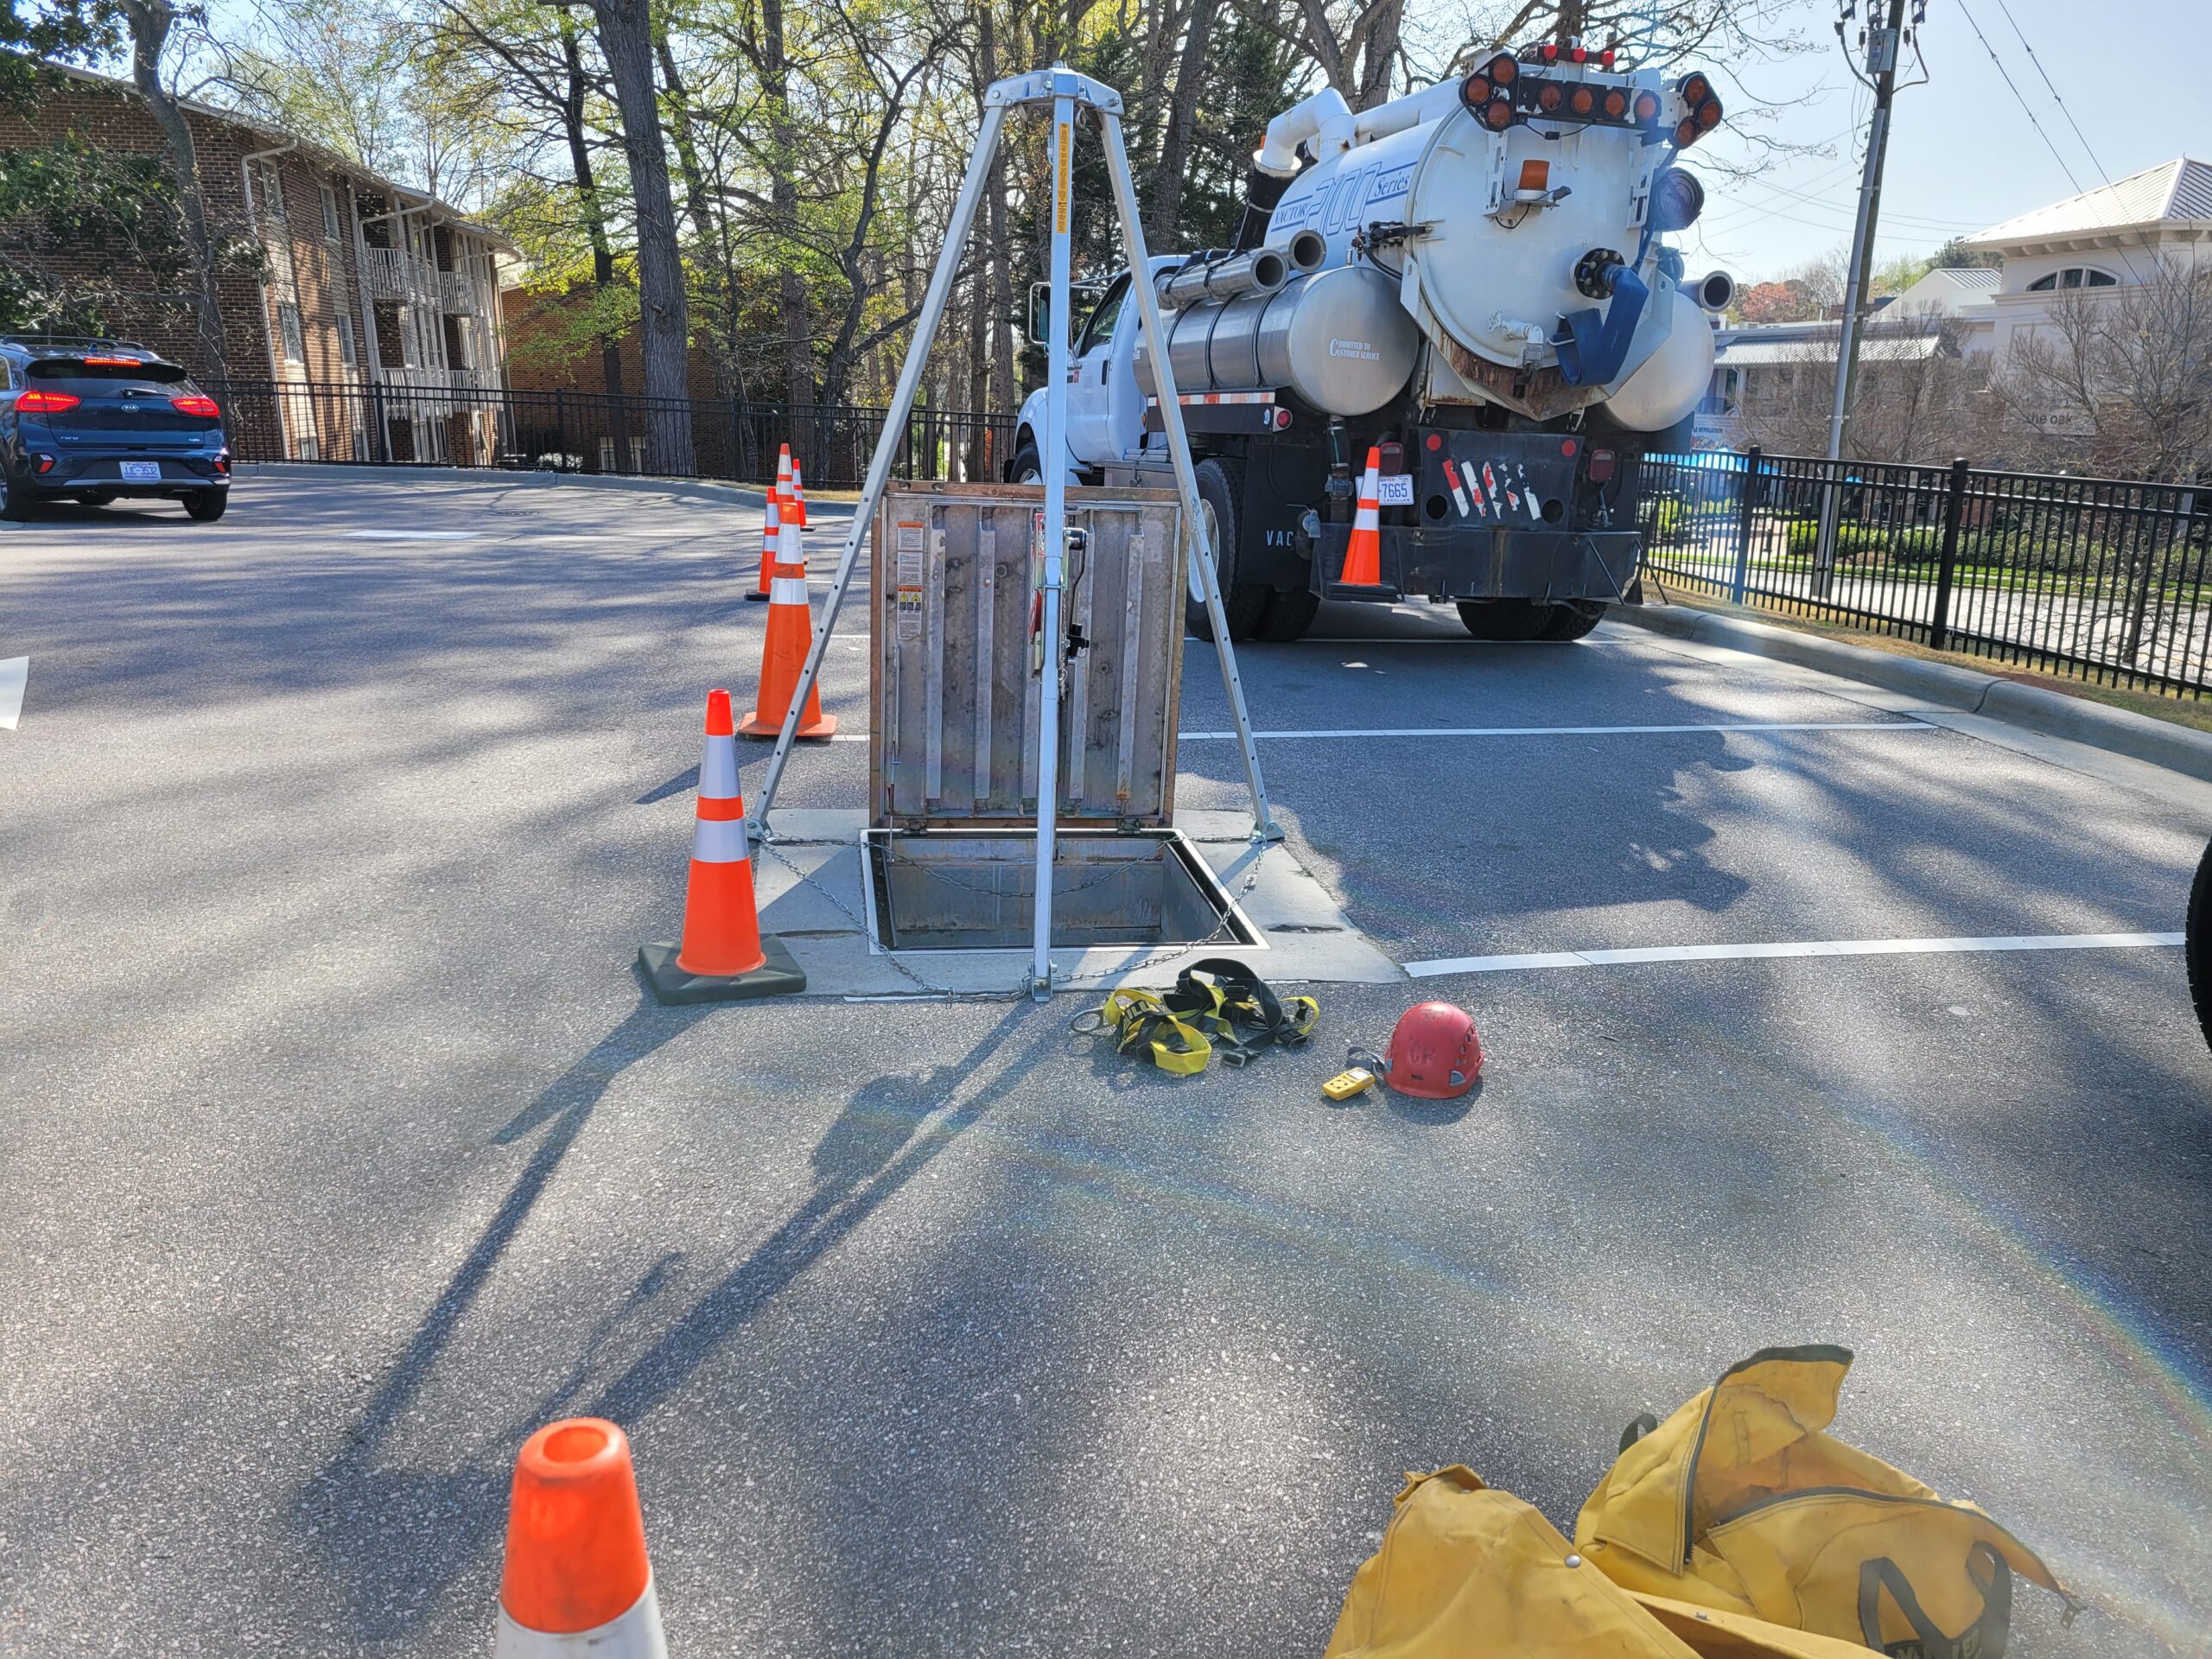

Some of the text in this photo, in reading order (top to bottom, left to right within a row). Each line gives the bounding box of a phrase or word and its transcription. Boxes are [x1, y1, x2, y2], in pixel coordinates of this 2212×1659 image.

[1303, 161, 1382, 237] 2100
[1375, 171, 1410, 197] Series
[1378, 483, 1408, 498] -7665
